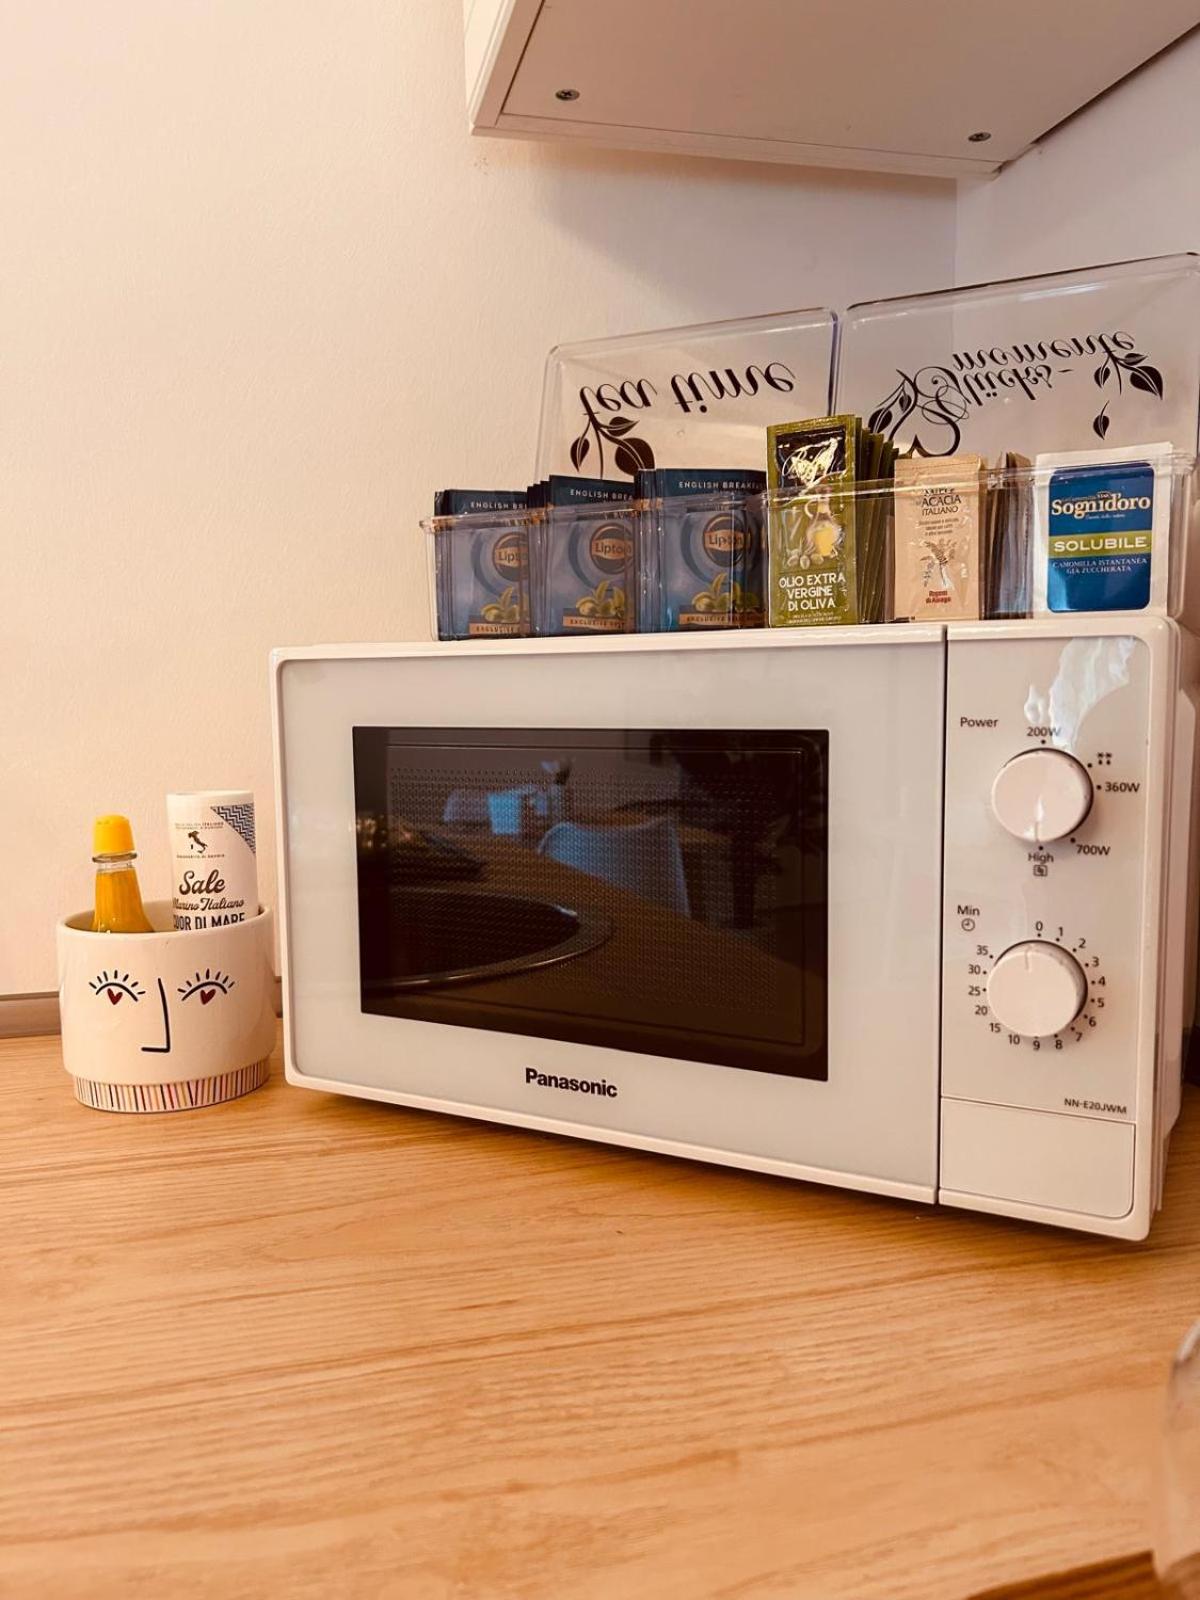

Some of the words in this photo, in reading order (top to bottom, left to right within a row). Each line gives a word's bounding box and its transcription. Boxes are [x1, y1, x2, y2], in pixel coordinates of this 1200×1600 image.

[678, 481, 719, 489] ENGLISH
[570, 489, 609, 499] ENGLISH
[470, 501, 509, 509] ENGLISH
[921, 494, 962, 508] ACACIA
[922, 505, 959, 516] ITALIANO
[1054, 536, 1147, 552] SOLUBILE
[1098, 558, 1148, 566] ISTANTANEA
[779, 575, 804, 588] OLIO
[807, 572, 846, 586] EXTRA
[786, 585, 833, 599] VERGINE
[788, 600, 799, 611] DI
[800, 597, 836, 610] OLIVA
[960, 716, 998, 728] Power
[1026, 727, 1061, 738] 200W
[1105, 782, 1140, 793] 360W
[1076, 844, 1111, 856] 700W
[1028, 853, 1054, 864] High
[179, 869, 226, 895] Sale
[200, 897, 244, 911] Italiano
[957, 904, 980, 917] Min
[195, 916, 207, 929] DI
[1035, 921, 1043, 931] 0
[1058, 927, 1064, 936] 1
[1078, 938, 1086, 948] 2
[976, 945, 988, 956] 35
[1091, 957, 1100, 967] 3
[968, 964, 981, 975] 30
[1098, 976, 1106, 986] 4
[968, 985, 981, 996] 25
[1097, 998, 1105, 1008] 5
[975, 1005, 988, 1015] 20
[1089, 1017, 1097, 1027] 6
[989, 1023, 1001, 1033] 15
[1008, 1034, 1021, 1045] 10
[1076, 1032, 1083, 1042] 7
[1033, 1040, 1040, 1050] 9
[1055, 1040, 1063, 1050] 8
[525, 1067, 618, 1098] Panasonic
[1064, 1097, 1128, 1114] NN-E20JWM
